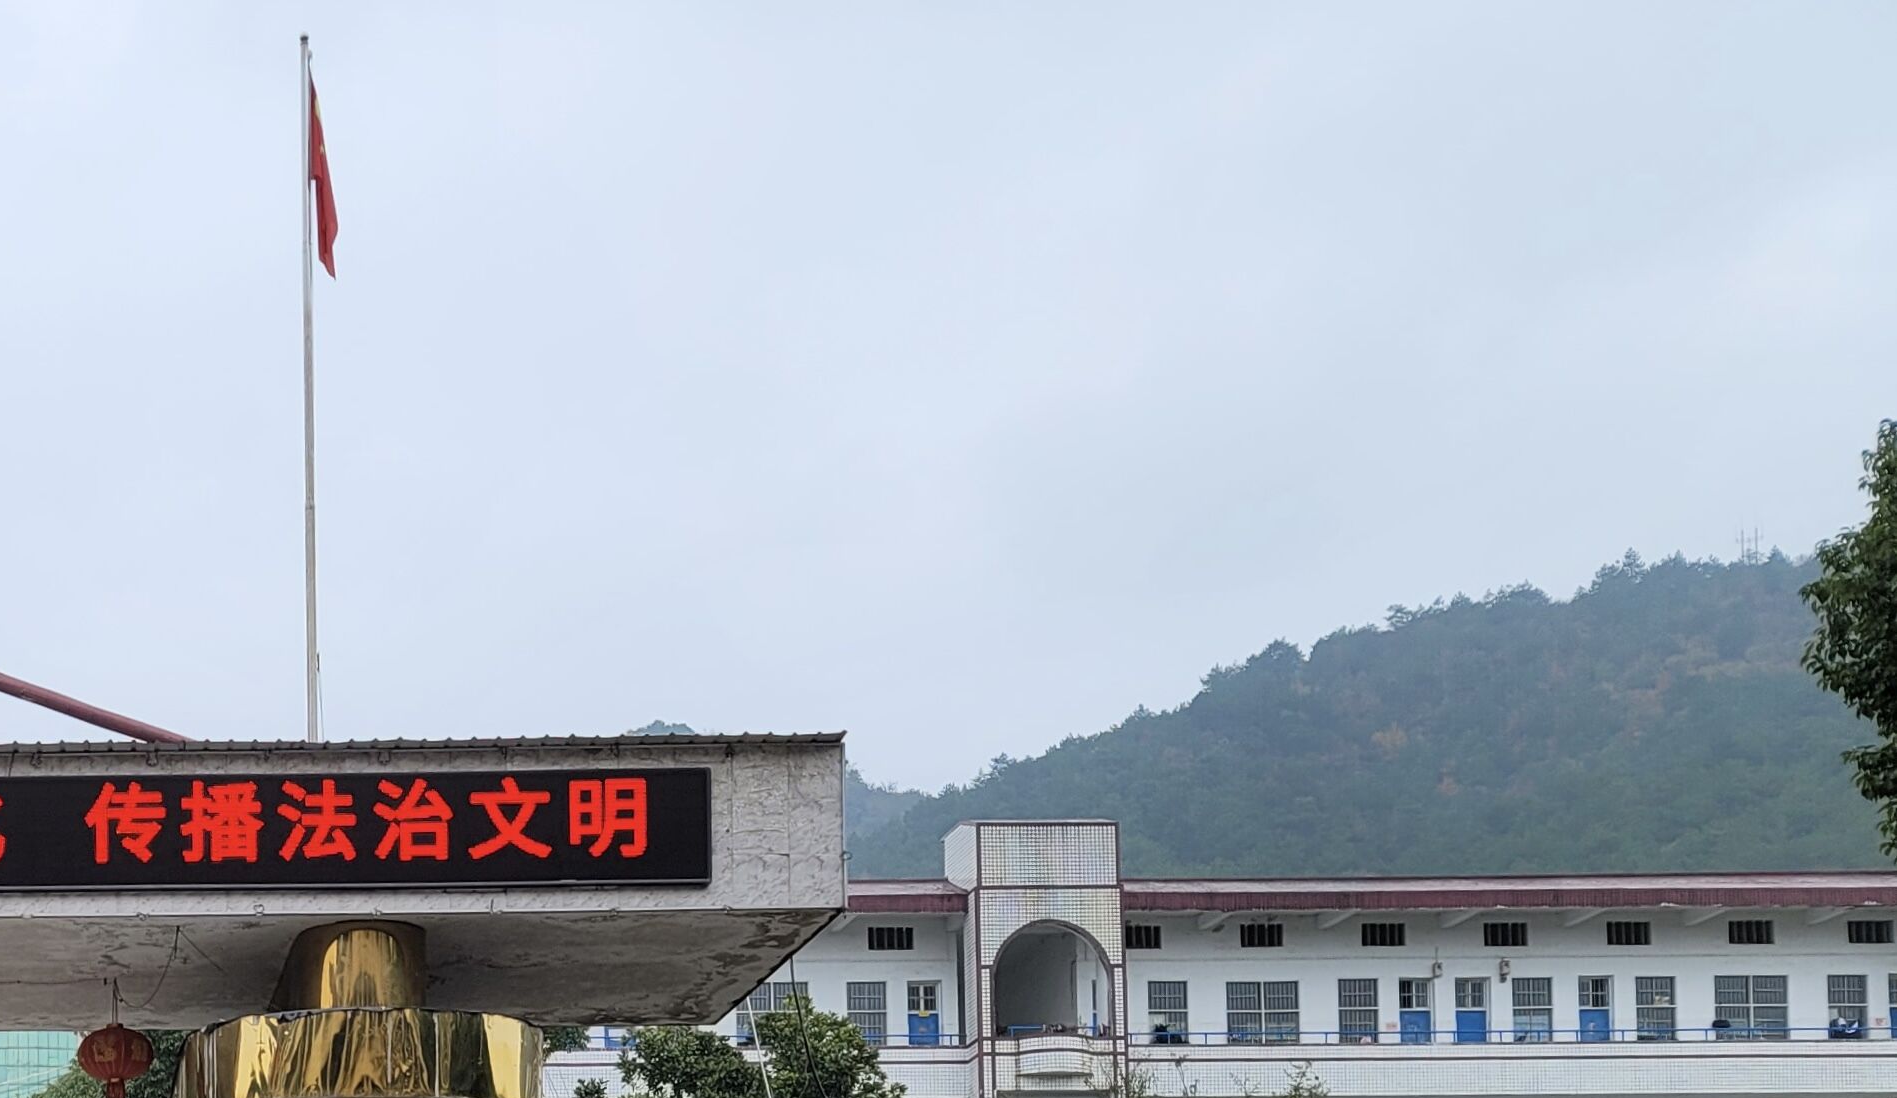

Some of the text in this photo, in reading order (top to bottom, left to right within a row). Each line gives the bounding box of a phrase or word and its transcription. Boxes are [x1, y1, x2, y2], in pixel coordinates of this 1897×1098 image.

[85, 777, 647, 863] 传播法治文明
